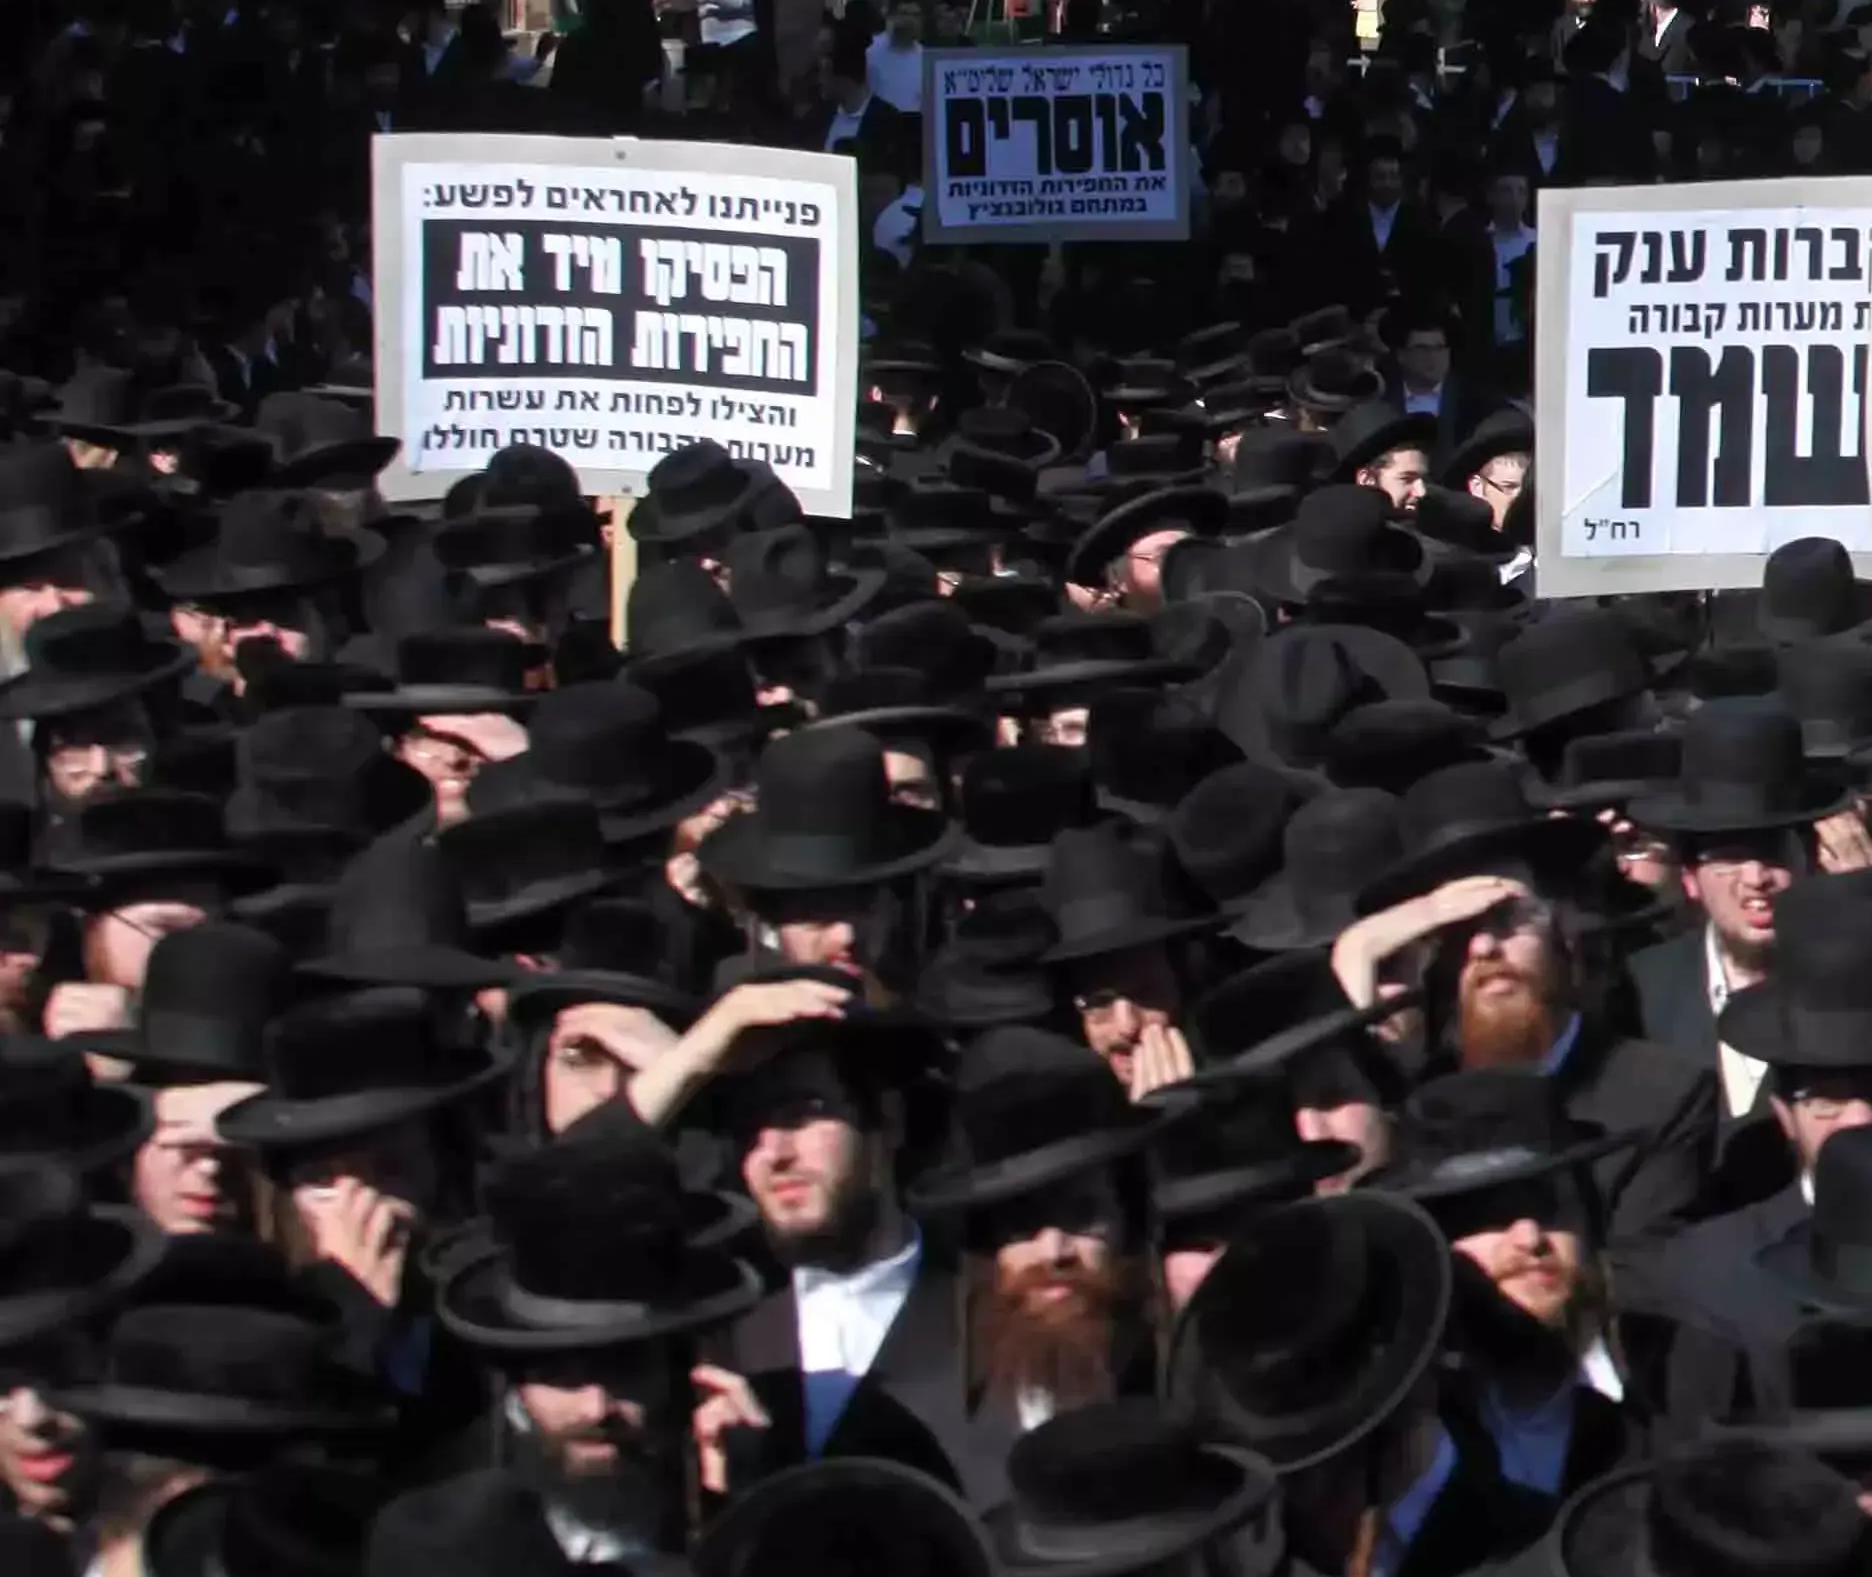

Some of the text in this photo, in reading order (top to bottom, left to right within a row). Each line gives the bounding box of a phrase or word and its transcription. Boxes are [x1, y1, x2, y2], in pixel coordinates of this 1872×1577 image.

[1021, 63, 1081, 92] ישראל
[1089, 62, 1135, 89] גדולי
[1140, 60, 1166, 89] כל
[945, 91, 1167, 177] אוסרים
[1040, 177, 1128, 195] החפירות
[1133, 175, 1167, 192] את
[423, 178, 821, 226] פנייתנו לאחראים לפשע:
[1070, 197, 1147, 215] במתחם
[456, 231, 788, 307] הפסיקו מיד את
[1593, 229, 1707, 298] ענק
[1628, 302, 1727, 340] קבורה
[1737, 301, 1842, 331] מערות
[432, 305, 808, 382] החפירות הזדוניות
[443, 388, 797, 428] והצילו לפחות את עשרות
[423, 423, 501, 453] חוללו
[510, 426, 599, 451] שטרם
